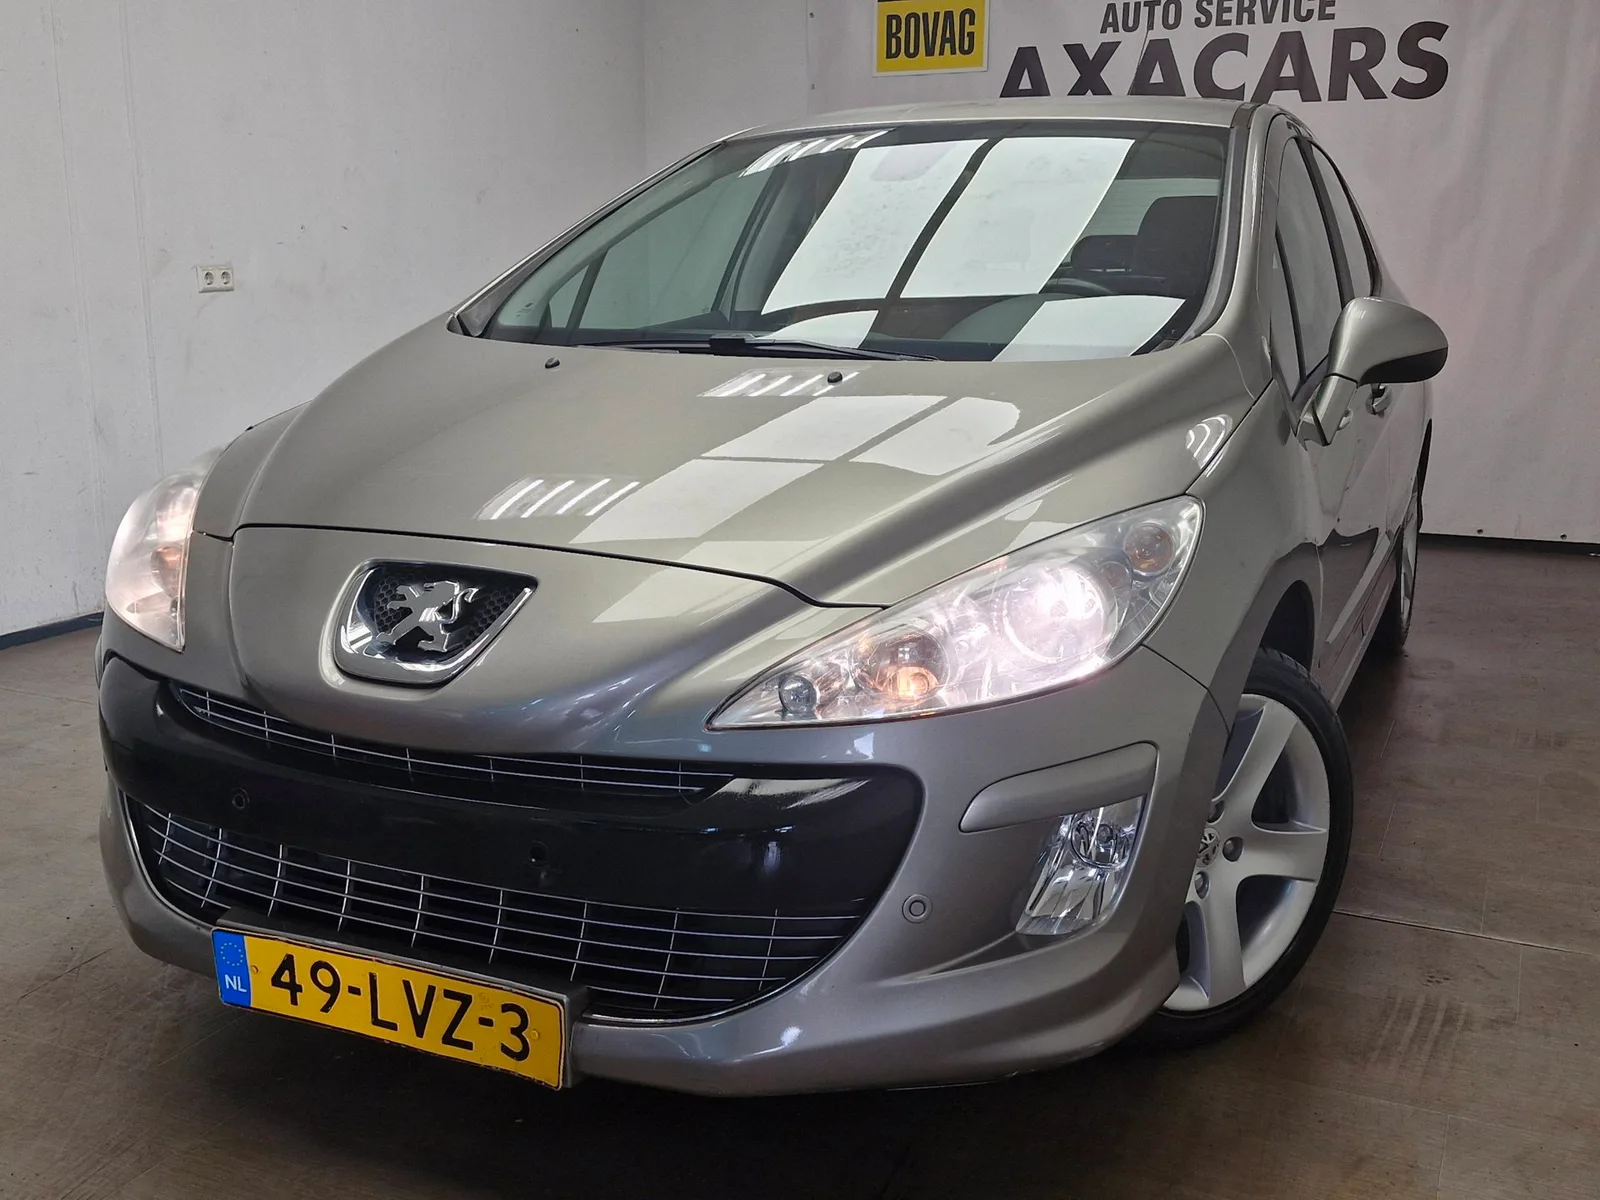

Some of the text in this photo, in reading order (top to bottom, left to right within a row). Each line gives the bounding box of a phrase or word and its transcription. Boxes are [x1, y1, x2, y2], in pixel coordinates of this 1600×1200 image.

[886, 8, 976, 59] BOVAG
[1100, 0, 1336, 34] AUTO SERVICE
[1000, 21, 1449, 103] AXACARS
[224, 974, 248, 993] NL
[270, 953, 531, 1062] 49-LVZ-3
